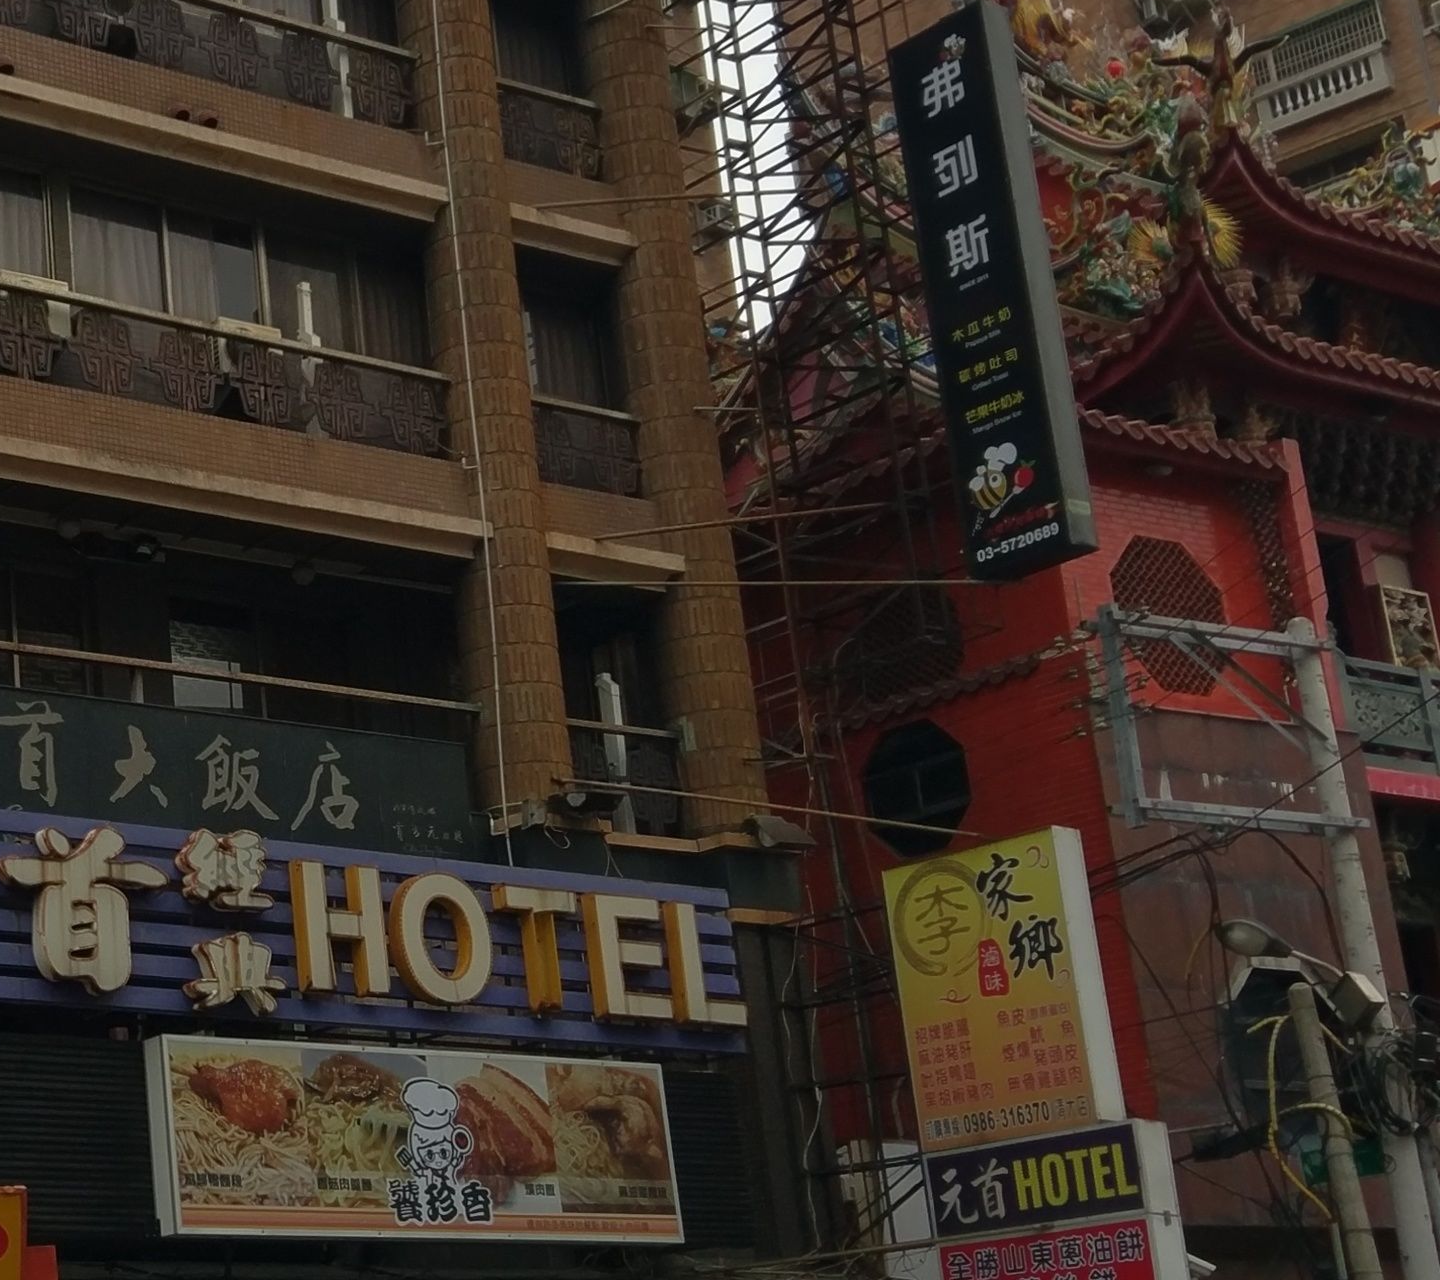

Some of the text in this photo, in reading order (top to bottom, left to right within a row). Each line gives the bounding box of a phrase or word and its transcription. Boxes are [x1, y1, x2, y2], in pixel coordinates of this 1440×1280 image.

[921, 63, 990, 278] 弗列斯
[952, 306, 1012, 342] 木瓜牛奶
[976, 522, 1060, 562] 03-5720689
[174, 827, 288, 1016] 經典
[289, 858, 748, 1028] HOTEL
[914, 852, 1064, 981] 李 家鄉
[980, 943, 1006, 994] 滷味
[963, 1101, 1051, 1134] 0986-316370
[938, 1143, 1140, 1226] 元首 HOTEL
